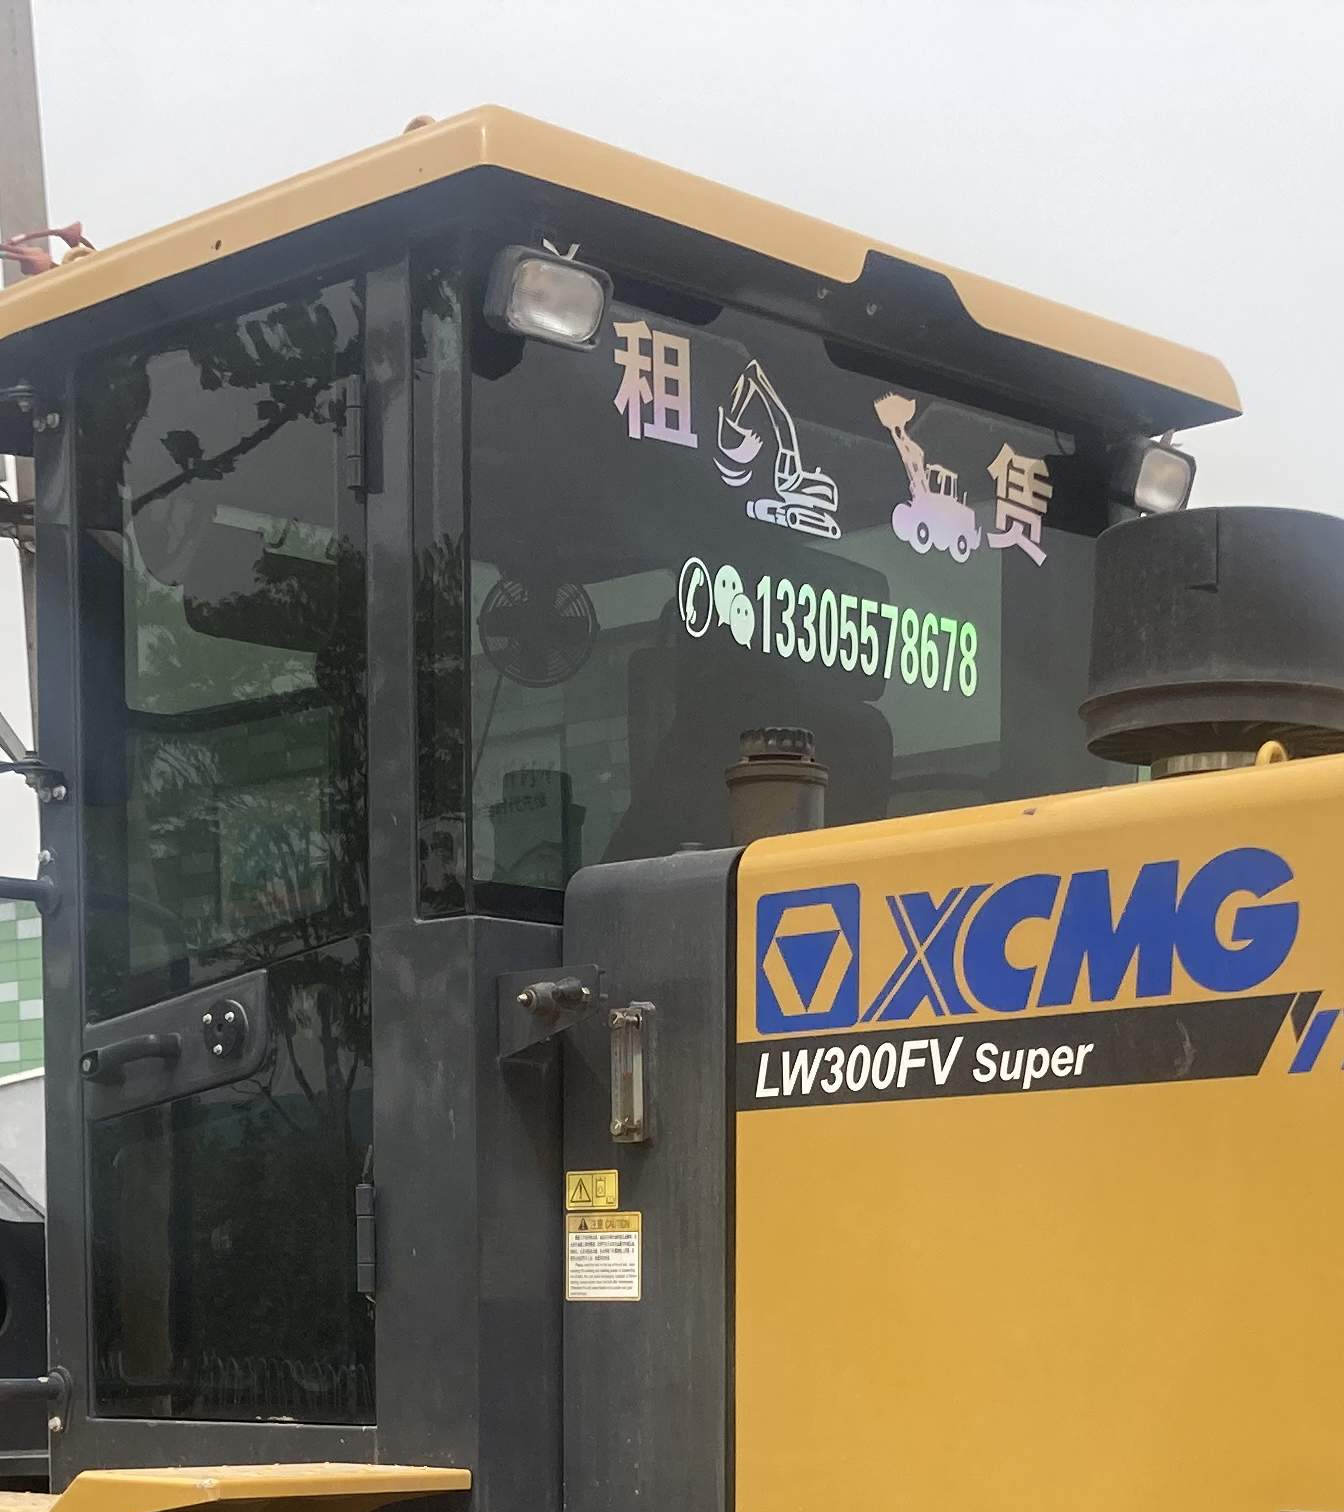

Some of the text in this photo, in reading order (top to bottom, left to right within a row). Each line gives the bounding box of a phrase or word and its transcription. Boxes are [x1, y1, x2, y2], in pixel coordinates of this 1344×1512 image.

[613, 320, 1053, 567] 租 赁
[757, 575, 978, 697] 13305578678
[859, 847, 1300, 1023] XCMG
[755, 1036, 1094, 1099] LW300FV Super
